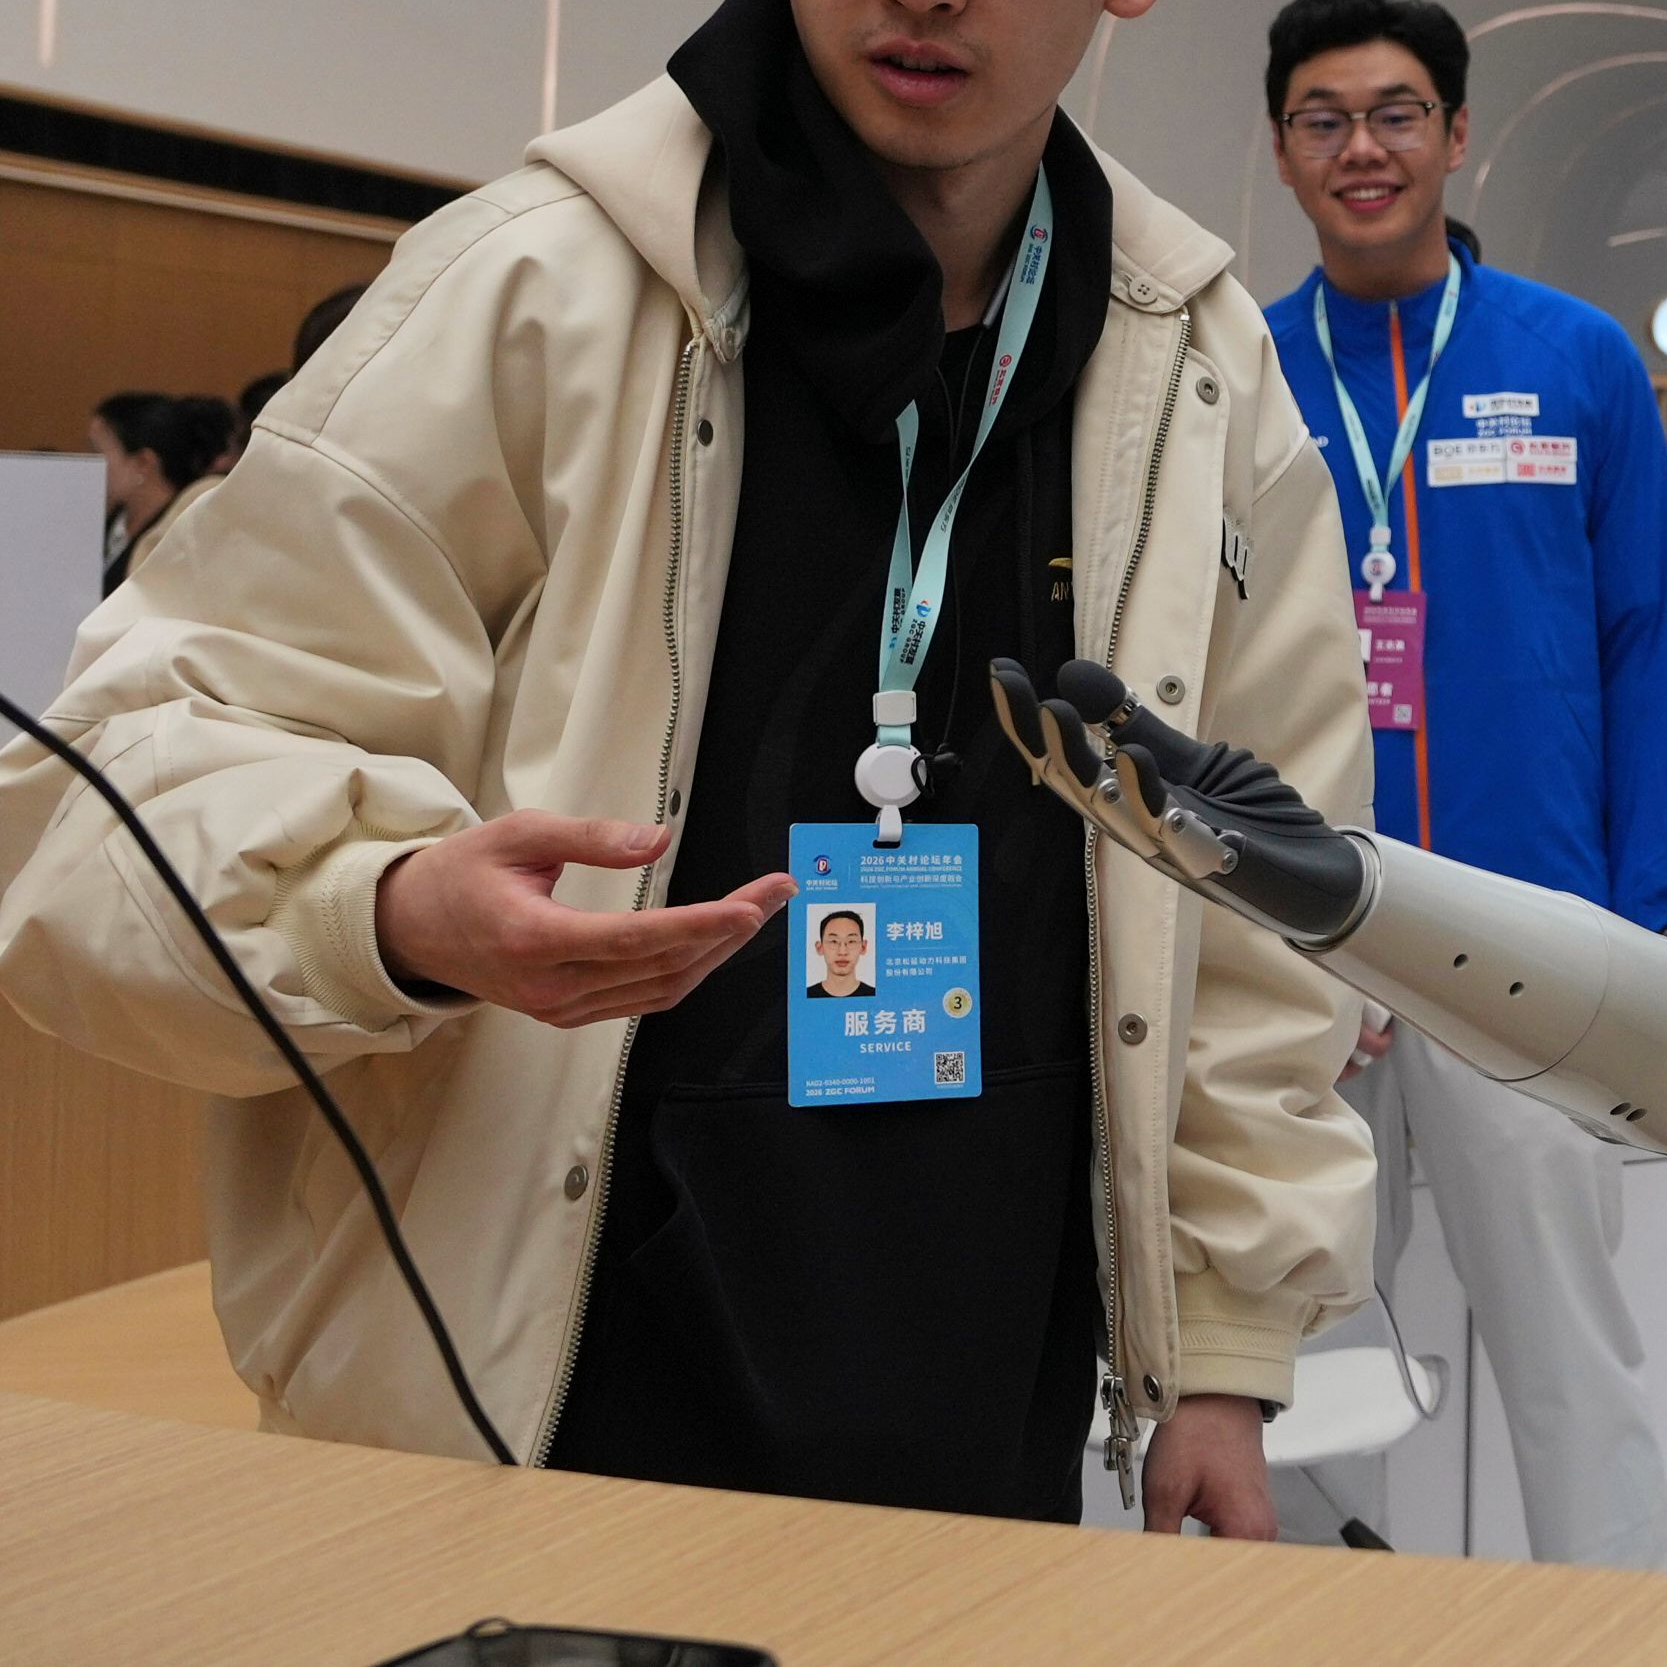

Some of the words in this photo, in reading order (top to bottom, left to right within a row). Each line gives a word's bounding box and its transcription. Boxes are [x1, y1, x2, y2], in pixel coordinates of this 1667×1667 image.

[1051, 582, 1073, 601] AN
[905, 621, 925, 665] 中关村发展
[861, 855, 962, 865] 2026中关村论坛年会
[886, 922, 943, 941] 李梓旭
[954, 997, 962, 1009] 3
[845, 1009, 926, 1036] 服务商
[860, 1041, 912, 1053] SERVICE
[845, 1087, 875, 1095] FORUM
